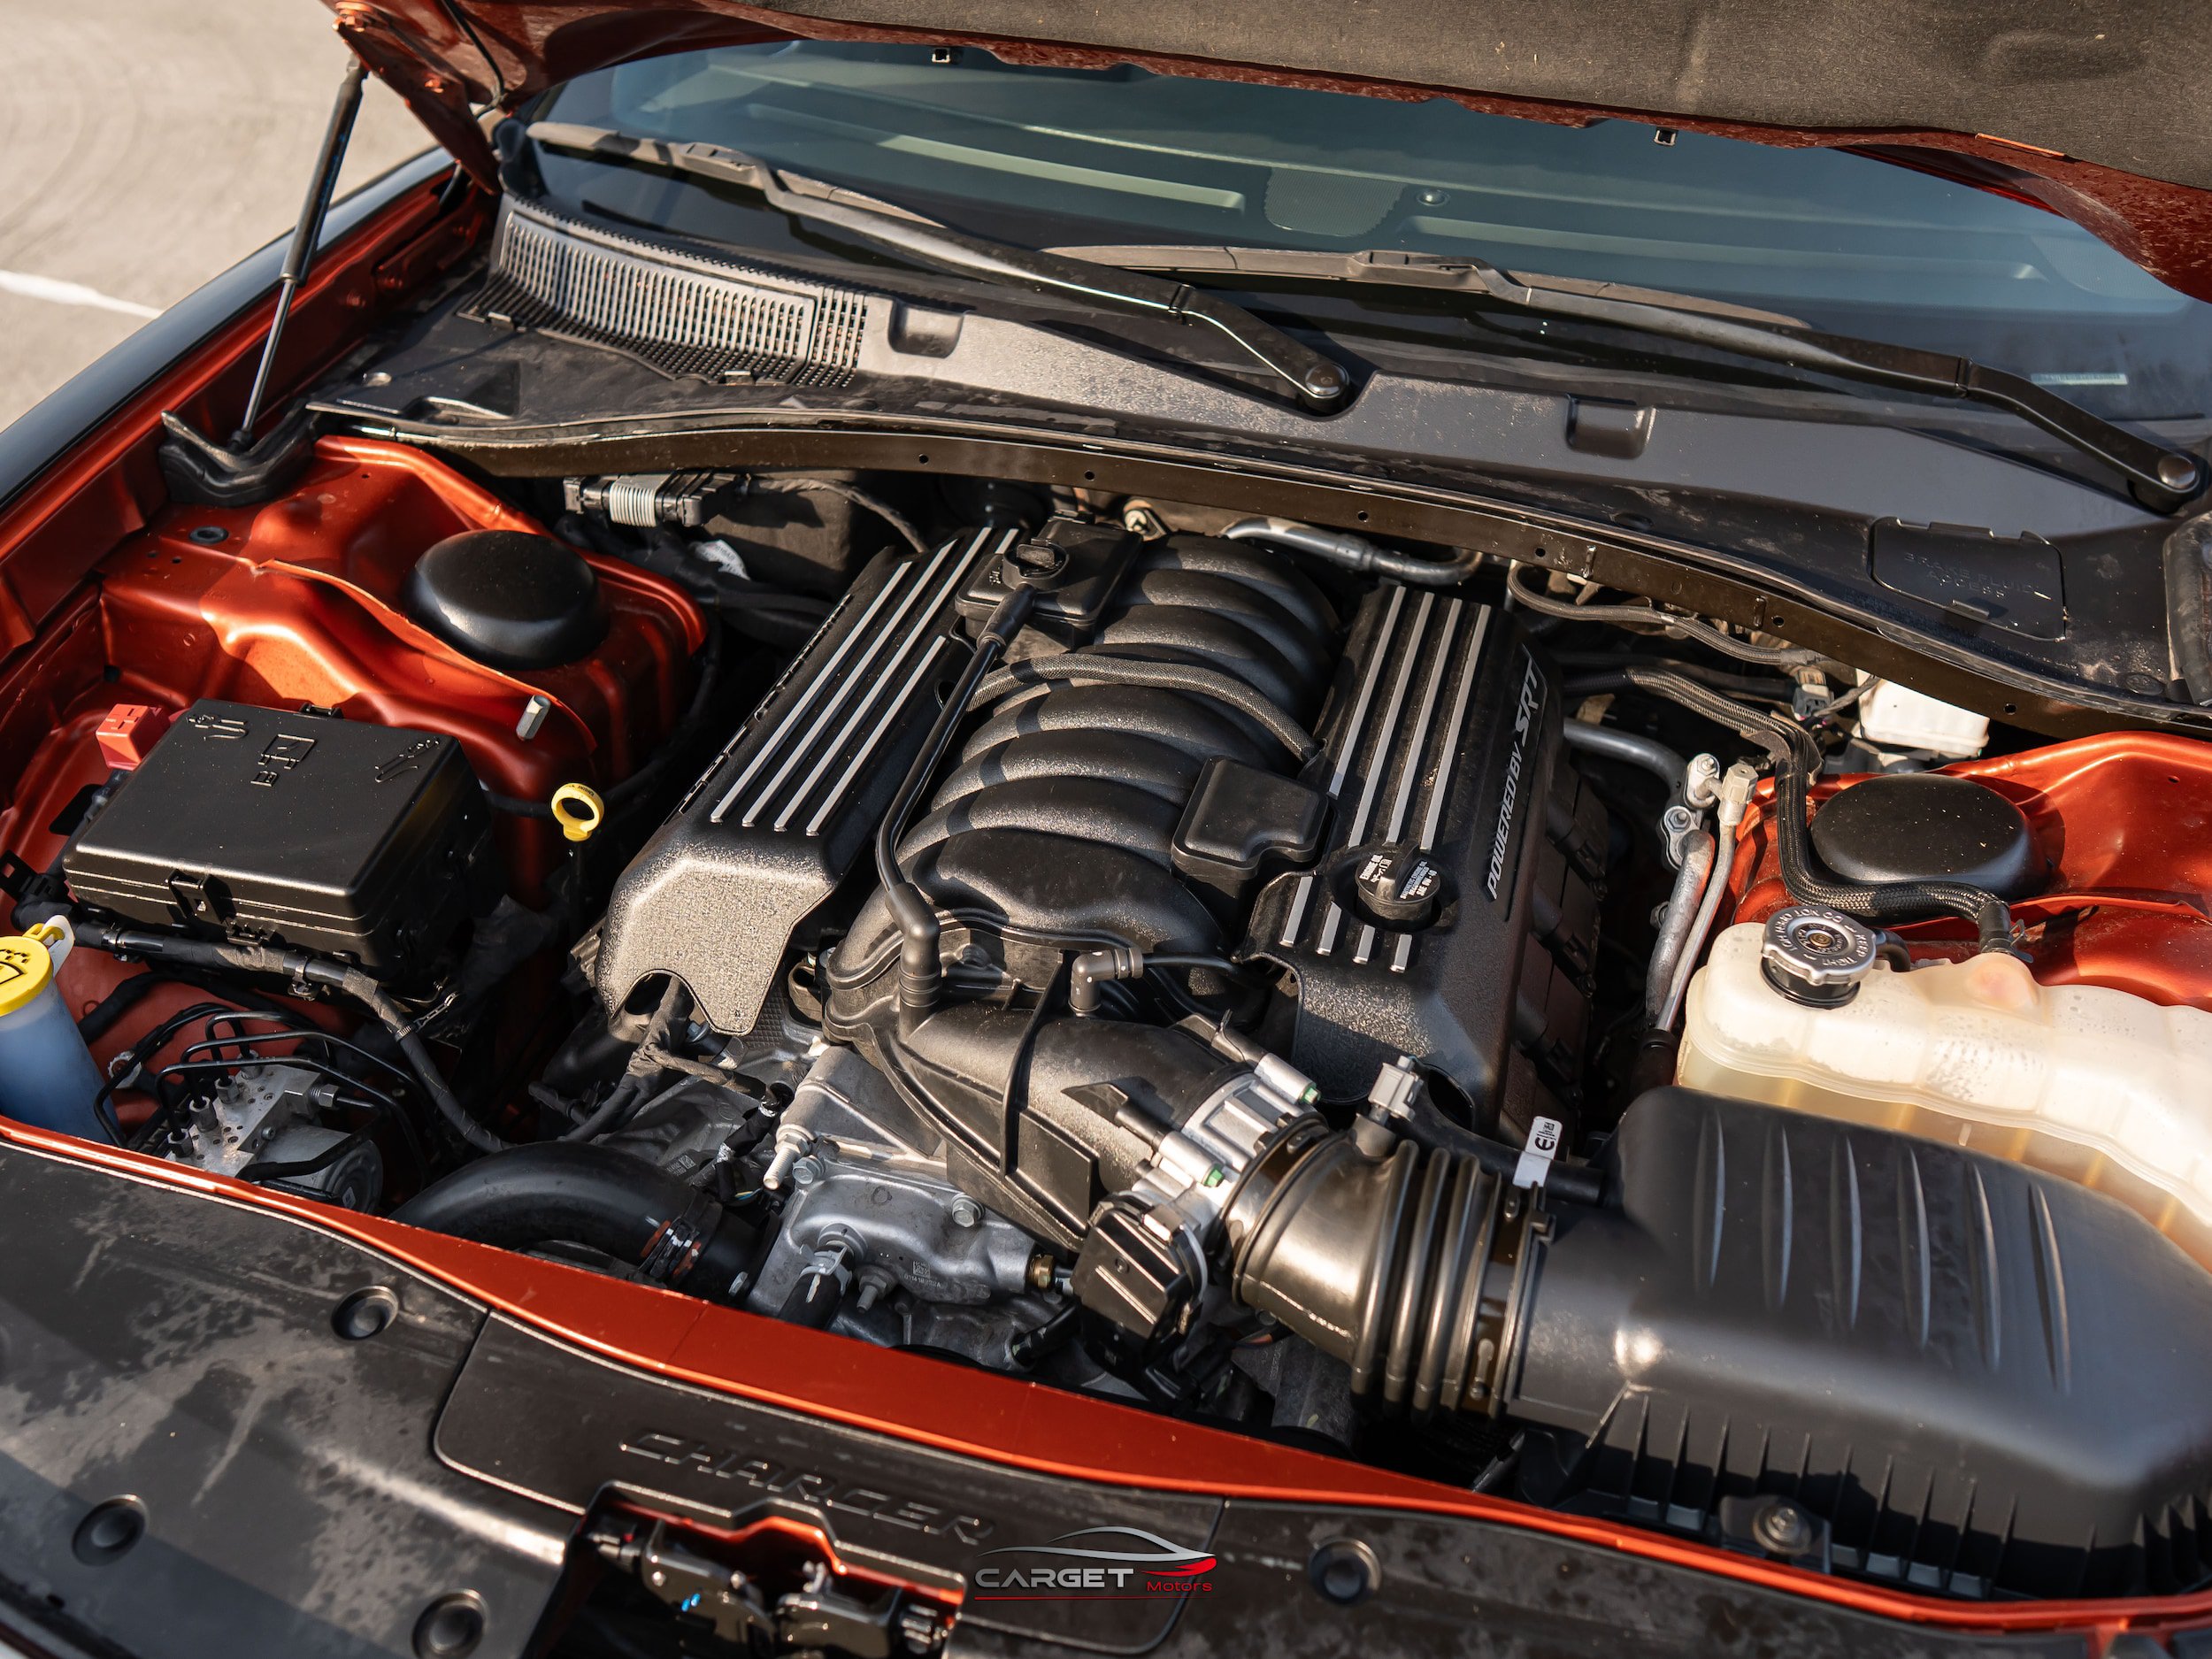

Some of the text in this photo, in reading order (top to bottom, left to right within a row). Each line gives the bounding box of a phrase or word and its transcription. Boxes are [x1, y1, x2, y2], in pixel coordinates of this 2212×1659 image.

[1904, 552, 2034, 595] BRAKE FLUID
[1927, 571, 2006, 598] ACCESS
[1486, 657, 1540, 900] POWERED BY SRT
[1793, 908, 1821, 918] NOT
[1855, 933, 1869, 957] KEEP
[1823, 956, 1858, 966] TIGHT
[619, 1431, 995, 1547] CHARGER
